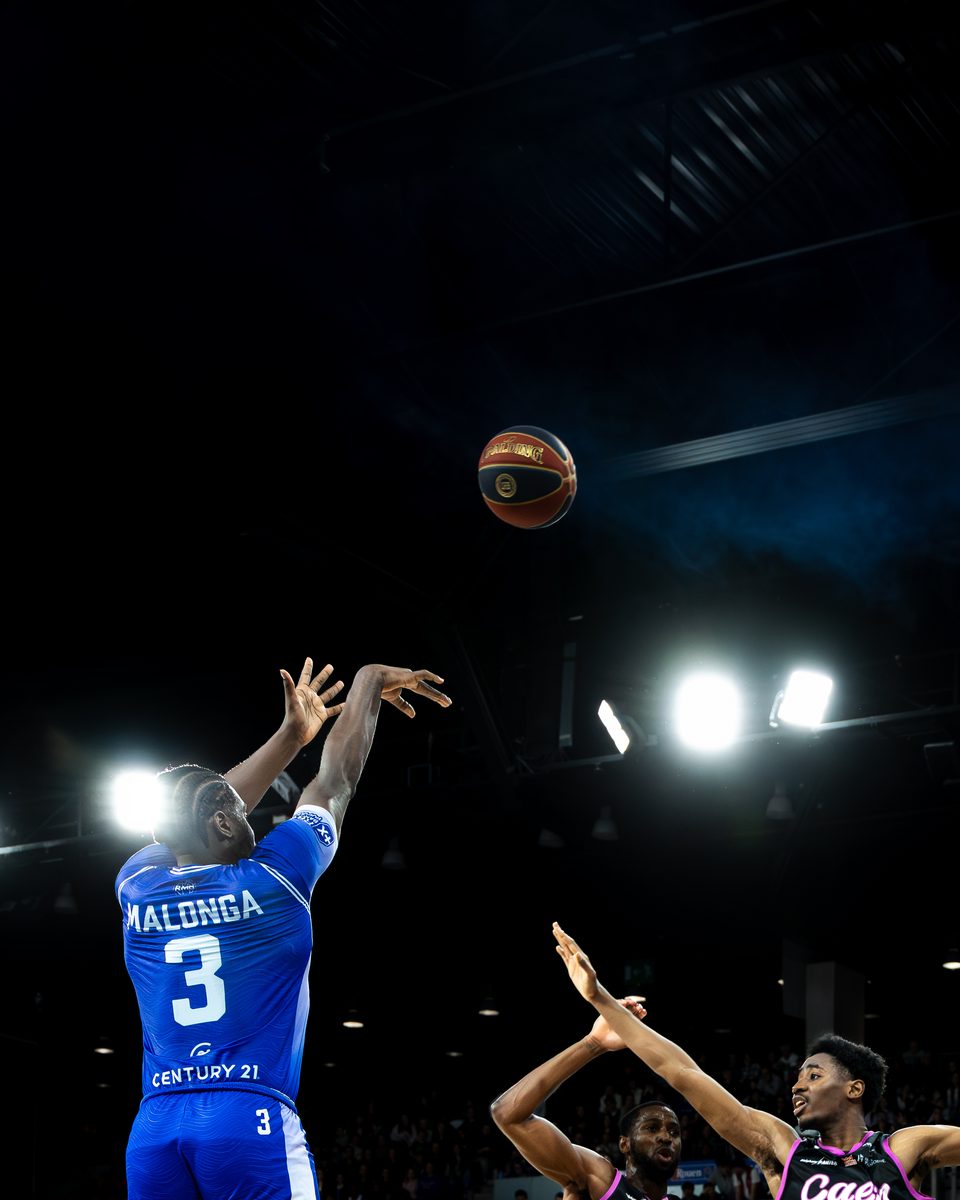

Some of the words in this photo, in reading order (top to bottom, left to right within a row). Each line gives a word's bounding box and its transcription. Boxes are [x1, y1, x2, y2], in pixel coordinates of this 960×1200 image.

[127, 889, 264, 933] MALONGA
[164, 933, 227, 1027] 3
[152, 1065, 236, 1088] CENTURY
[241, 1064, 260, 1080] 21
[256, 1108, 272, 1136] 3
